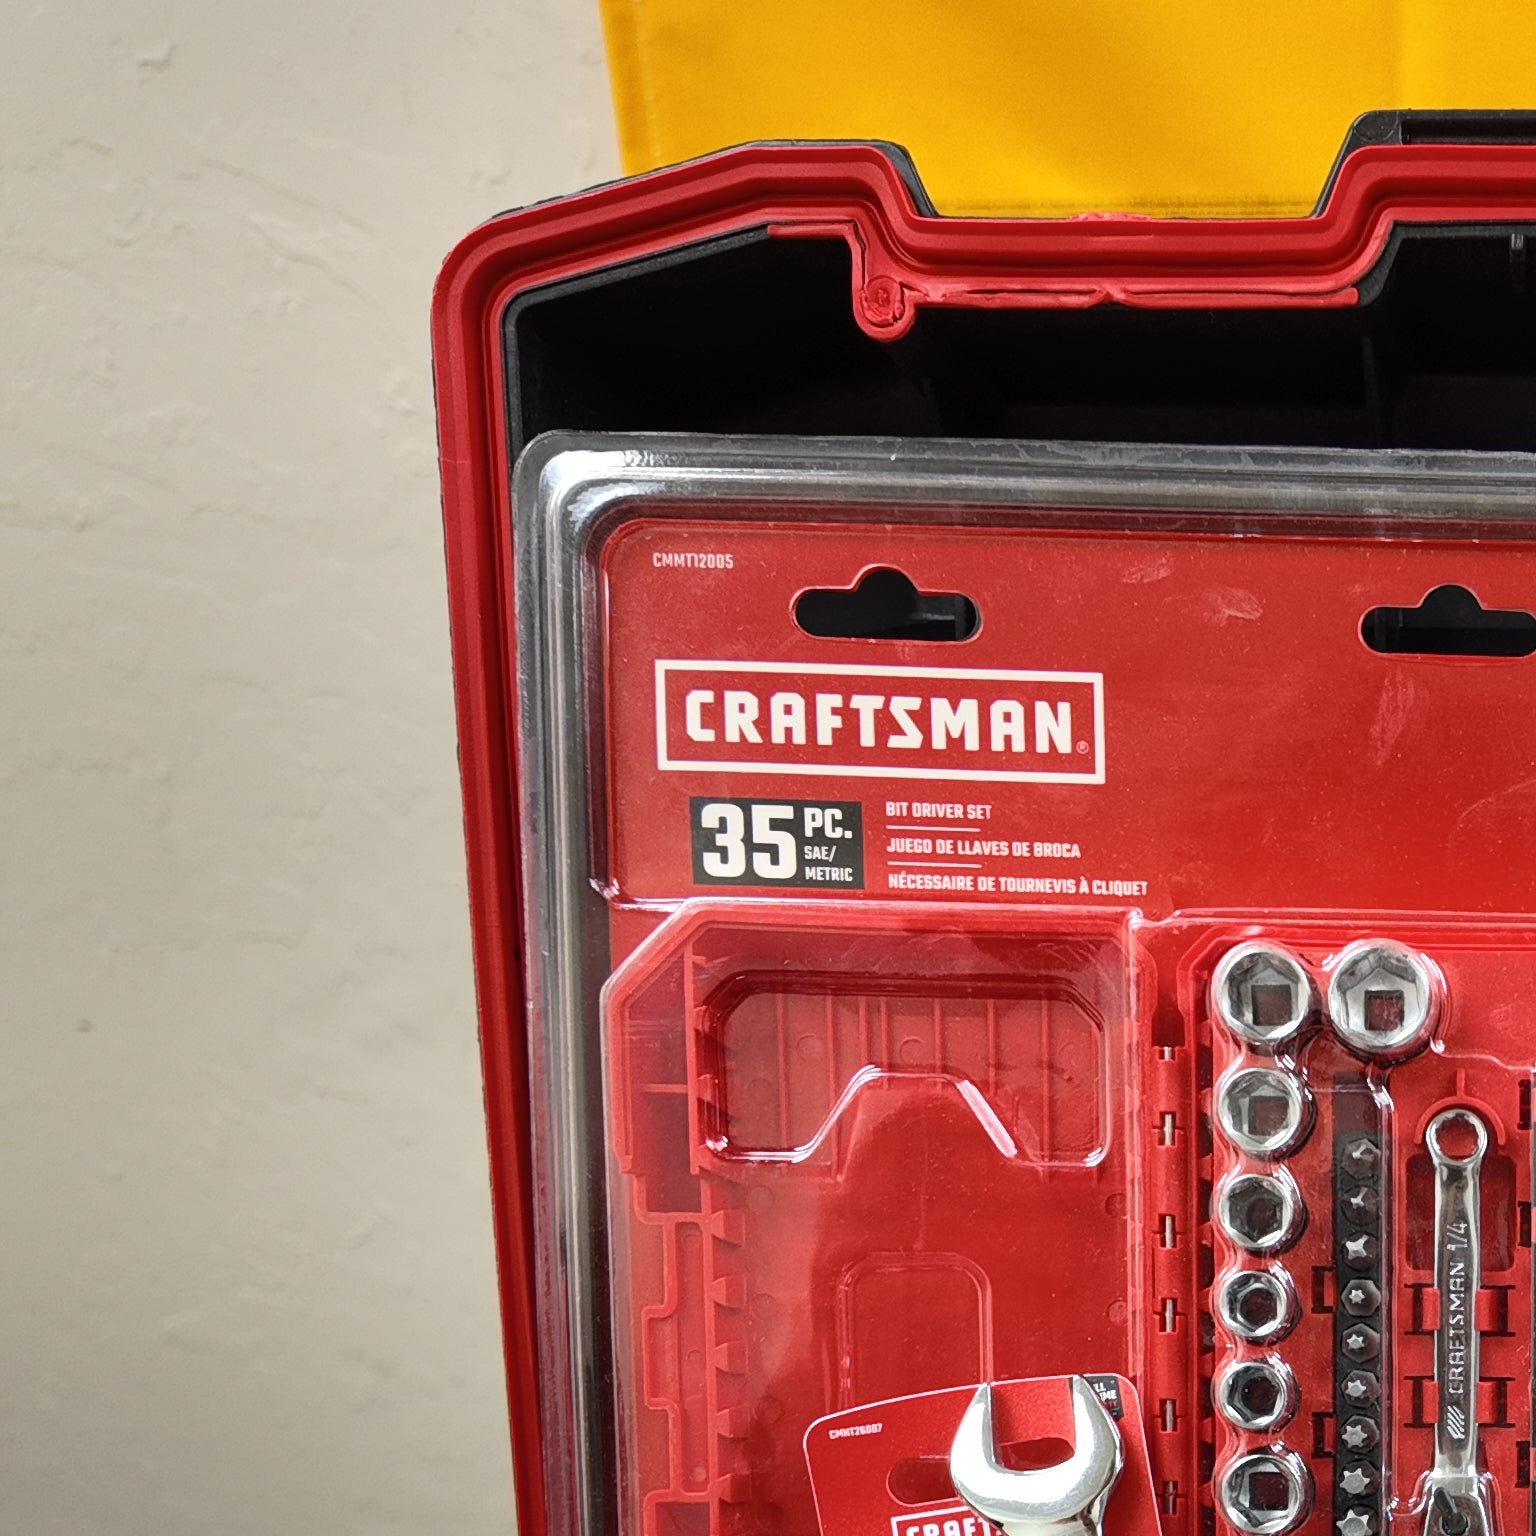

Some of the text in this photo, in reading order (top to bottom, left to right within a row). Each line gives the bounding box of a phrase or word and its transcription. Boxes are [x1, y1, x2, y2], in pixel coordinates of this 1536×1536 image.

[653, 553, 733, 569] CMMT12005
[885, 802, 991, 819] BIT DRIVER SET
[701, 804, 852, 879] 35 PC.
[887, 838, 1081, 858] JUEGO DE LLAVES DE BROCA
[804, 845, 836, 863] SAE/
[805, 866, 853, 881] METRIC
[1448, 1267, 1467, 1395] CRAFTSMAN
